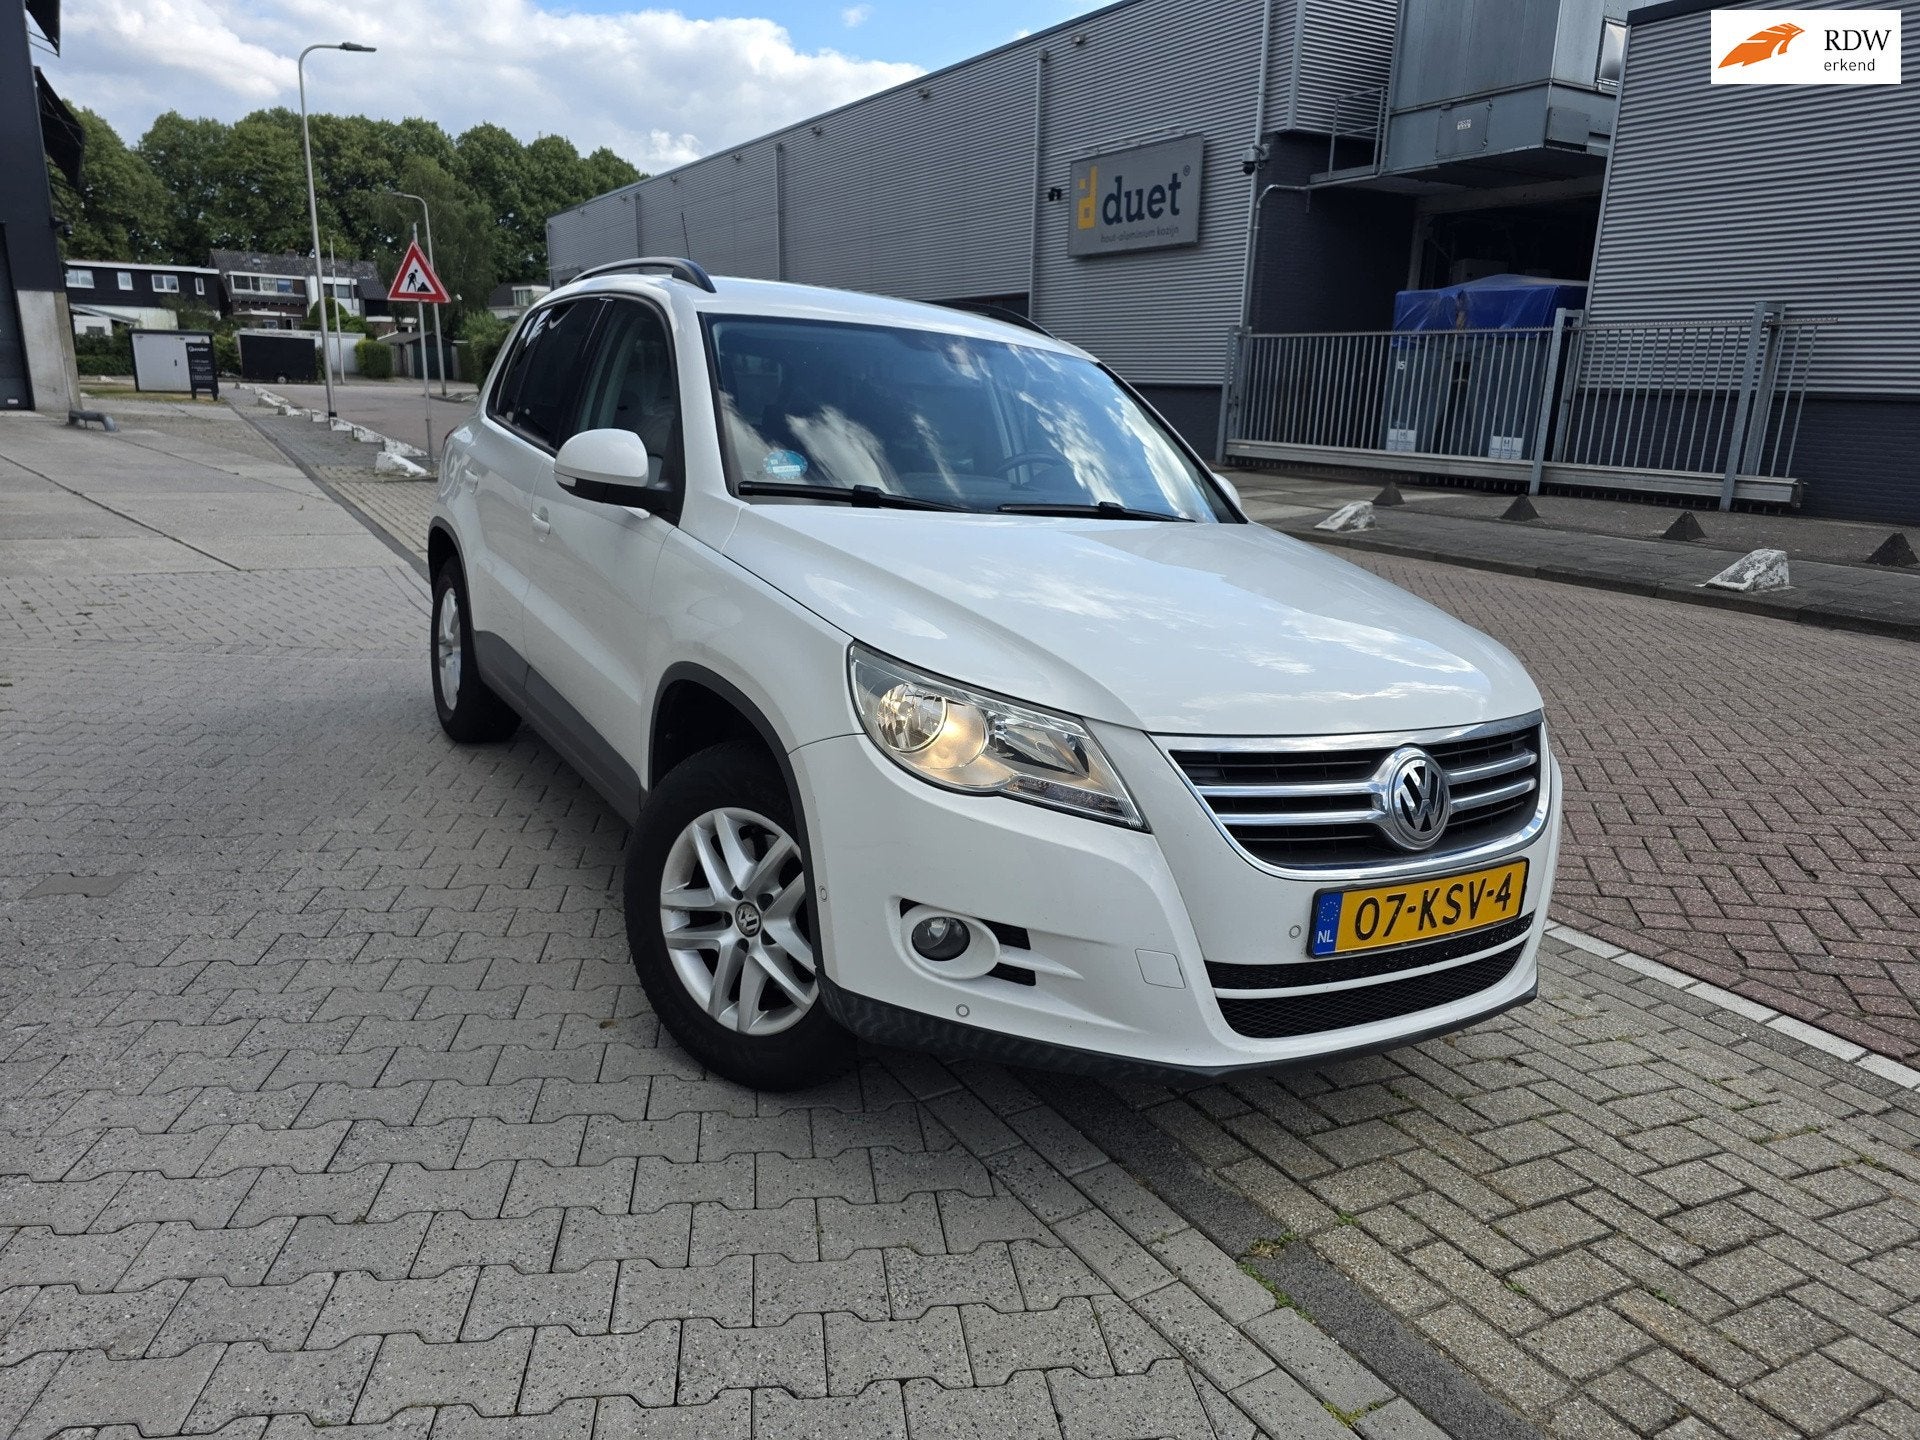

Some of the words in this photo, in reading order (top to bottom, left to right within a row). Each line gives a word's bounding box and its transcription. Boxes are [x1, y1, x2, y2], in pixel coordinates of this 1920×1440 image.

[1102, 172, 1182, 226] duet
[1392, 757, 1446, 839] VW
[1316, 929, 1334, 944] NL
[1354, 872, 1513, 941] 07-KSV-4
